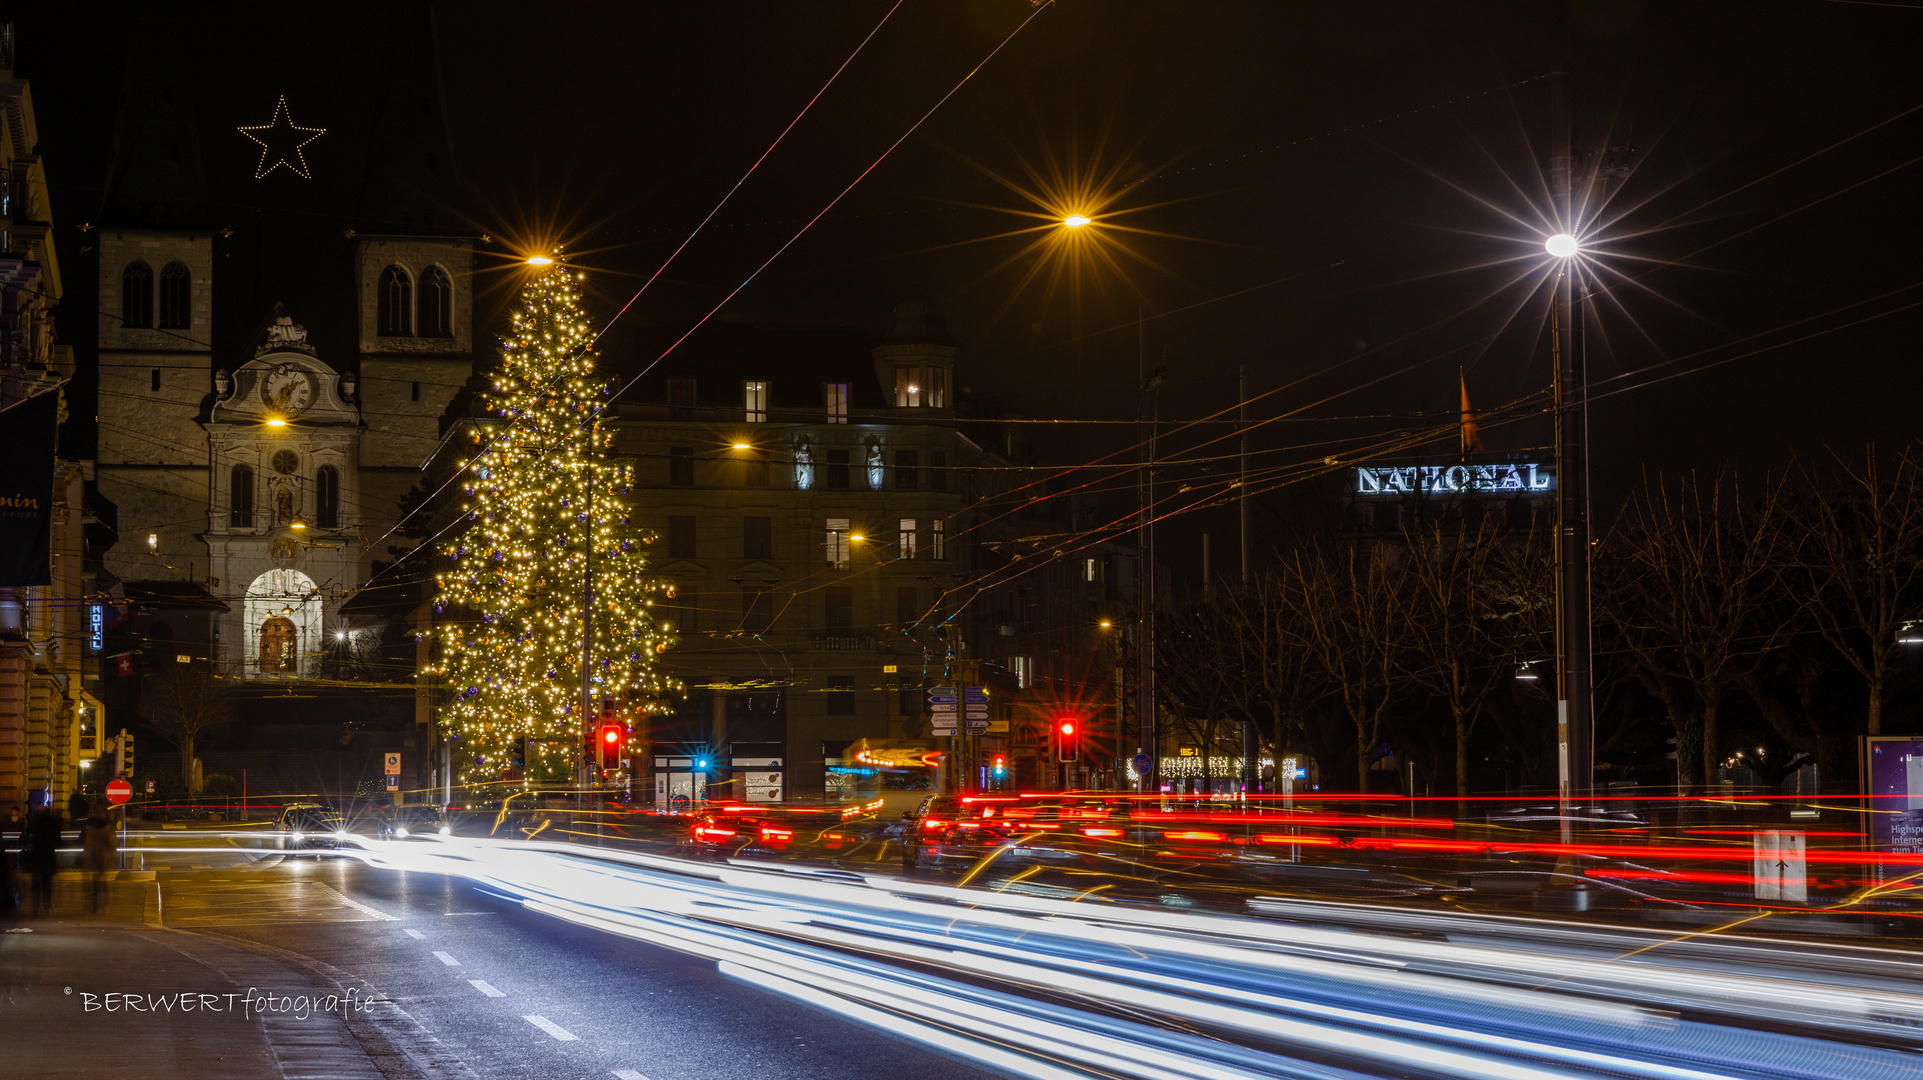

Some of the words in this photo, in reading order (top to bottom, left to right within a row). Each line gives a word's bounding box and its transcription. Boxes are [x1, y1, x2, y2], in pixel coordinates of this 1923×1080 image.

[1353, 463, 1550, 494] NATIONAL
[205, 576, 219, 587] A13
[92, 605, 101, 648] HOTEL
[1891, 836, 1923, 845] Interne
